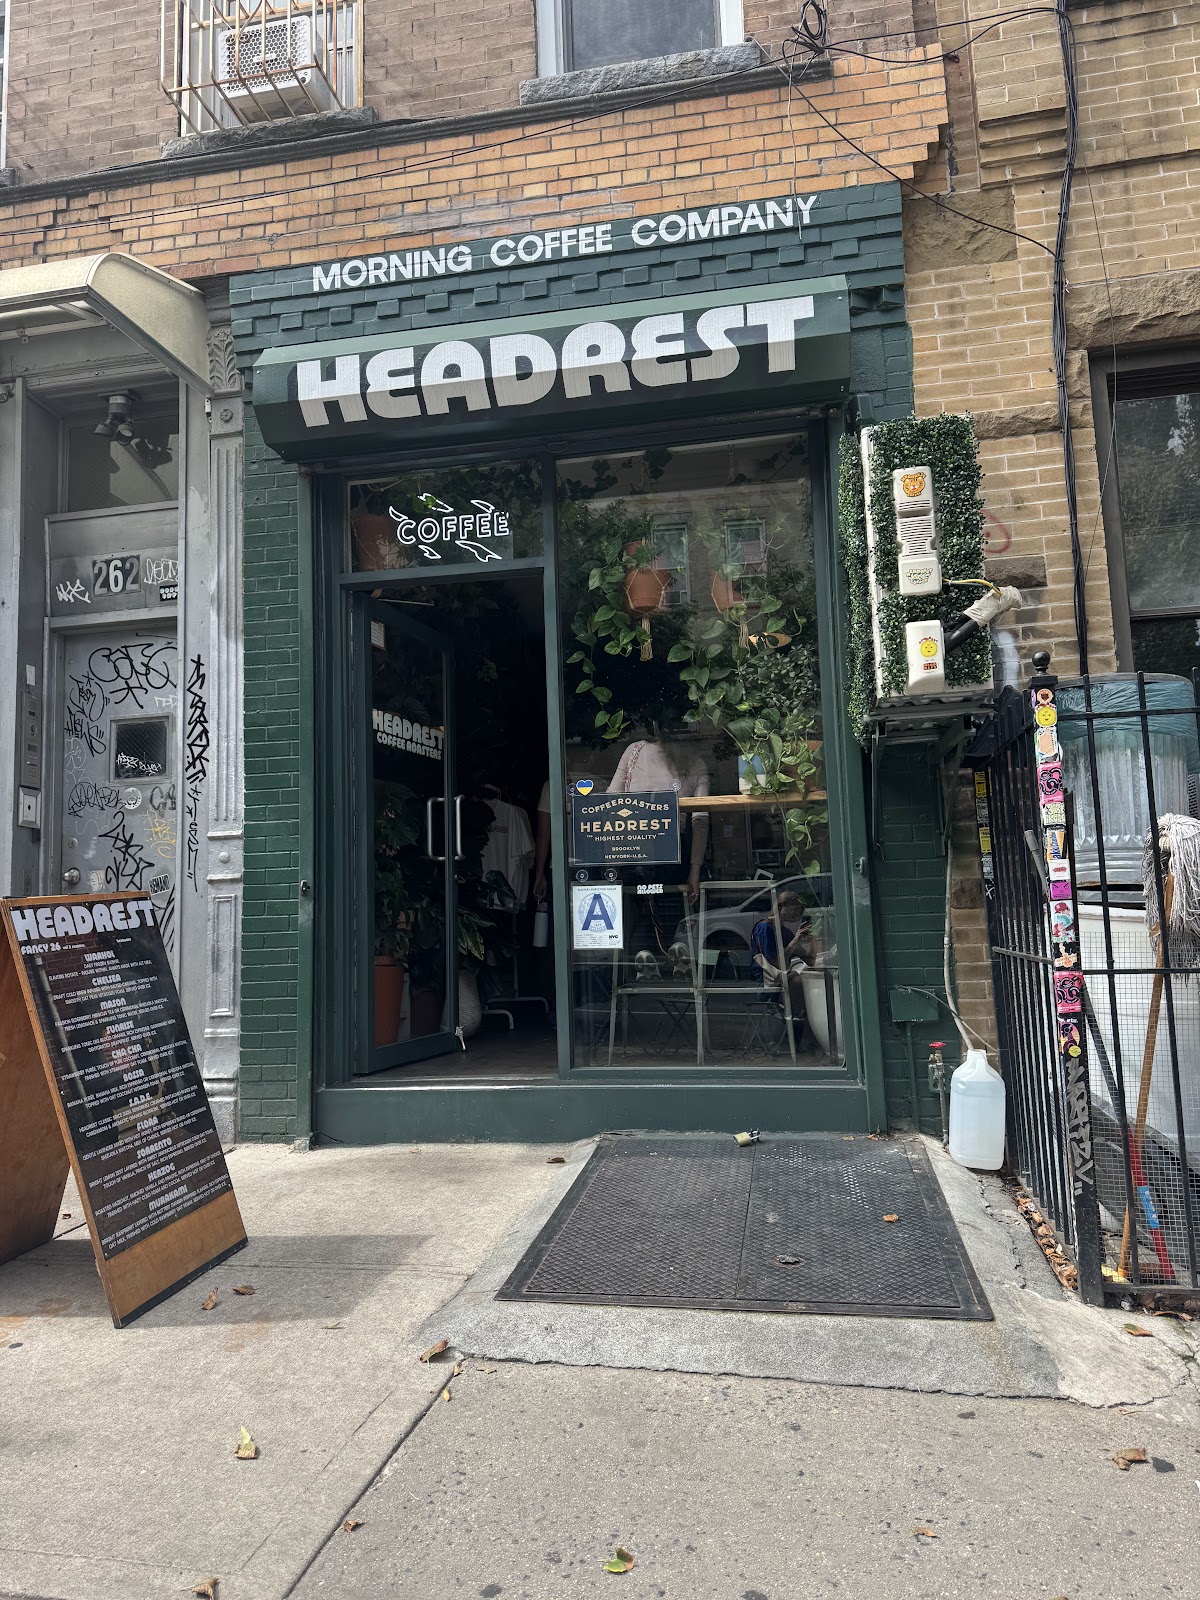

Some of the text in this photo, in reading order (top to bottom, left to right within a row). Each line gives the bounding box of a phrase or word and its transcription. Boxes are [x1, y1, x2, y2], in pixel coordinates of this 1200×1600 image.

[312, 196, 818, 291] MORNING COFFEE COMPANY
[296, 295, 815, 427] HEADREST
[397, 511, 510, 545] COFFEE
[93, 557, 140, 595] 262
[372, 708, 445, 750] HEADREST
[377, 732, 442, 760] COFFEE ROASTERS
[580, 818, 672, 832] HEADREST
[11, 901, 153, 941] HEADREST
[582, 894, 614, 930] A
[20, 943, 49, 955] FANCY
[49, 942, 61, 951] 26
[84, 950, 116, 962] WARHOL
[91, 974, 122, 986] CHELSEA
[100, 998, 126, 1010] MASON
[106, 1020, 135, 1034] SUNRISE
[111, 1048, 127, 1059] CHA
[127, 1044, 142, 1055] CHA
[122, 1068, 144, 1082] BOSSA
[128, 1092, 153, 1107] S.A.D.E.
[136, 1115, 159, 1131] FLORA
[136, 1136, 172, 1160] SORRENTO
[147, 1162, 176, 1182] HERZOG
[148, 1184, 188, 1212] MURAKAMI
